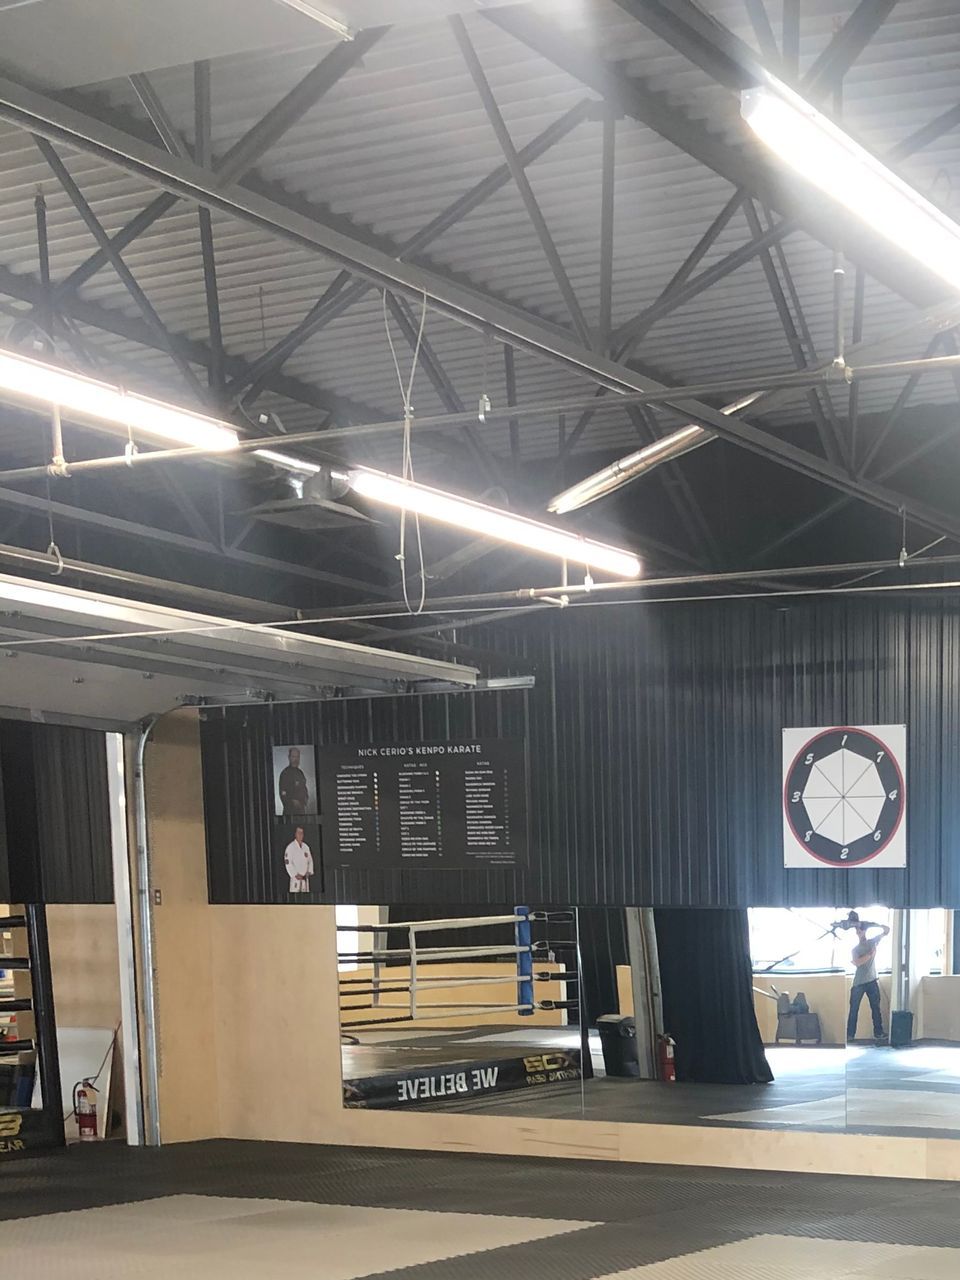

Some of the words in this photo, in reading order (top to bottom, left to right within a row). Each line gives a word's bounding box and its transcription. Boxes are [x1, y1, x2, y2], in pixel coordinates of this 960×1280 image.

[841, 735, 848, 746] 1
[358, 748, 378, 757] NICK
[380, 747, 414, 756] CERIO'S
[415, 746, 445, 755] KENPO
[447, 744, 481, 754] KARATE
[805, 754, 814, 764] 5
[877, 752, 884, 762] 7
[791, 791, 801, 803] 3
[889, 790, 897, 800] 4
[804, 831, 812, 841] 8
[874, 830, 881, 841] 6
[840, 848, 848, 859] 2
